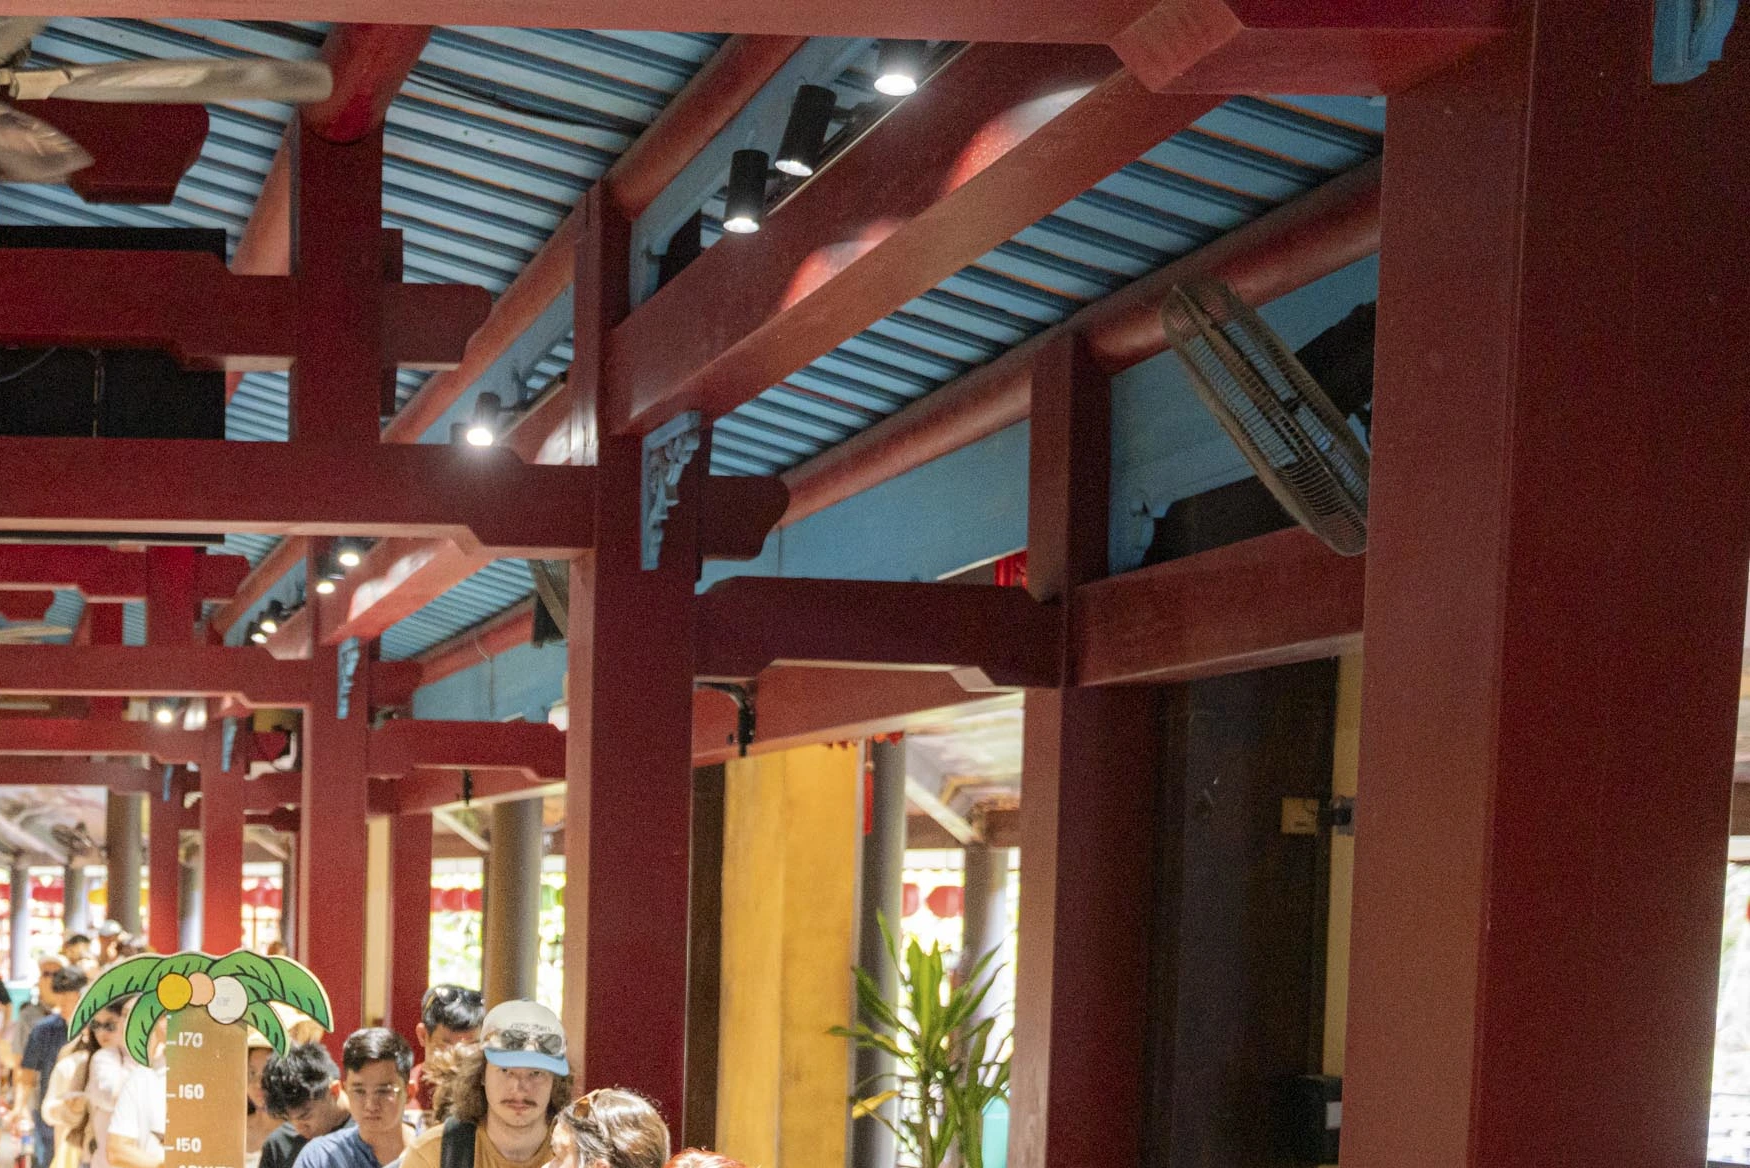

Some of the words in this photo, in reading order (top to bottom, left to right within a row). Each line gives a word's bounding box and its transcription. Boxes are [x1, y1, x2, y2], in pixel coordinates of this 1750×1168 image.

[178, 1031, 203, 1048] 170
[178, 1083, 204, 1100] 160
[176, 1137, 202, 1152] 150
